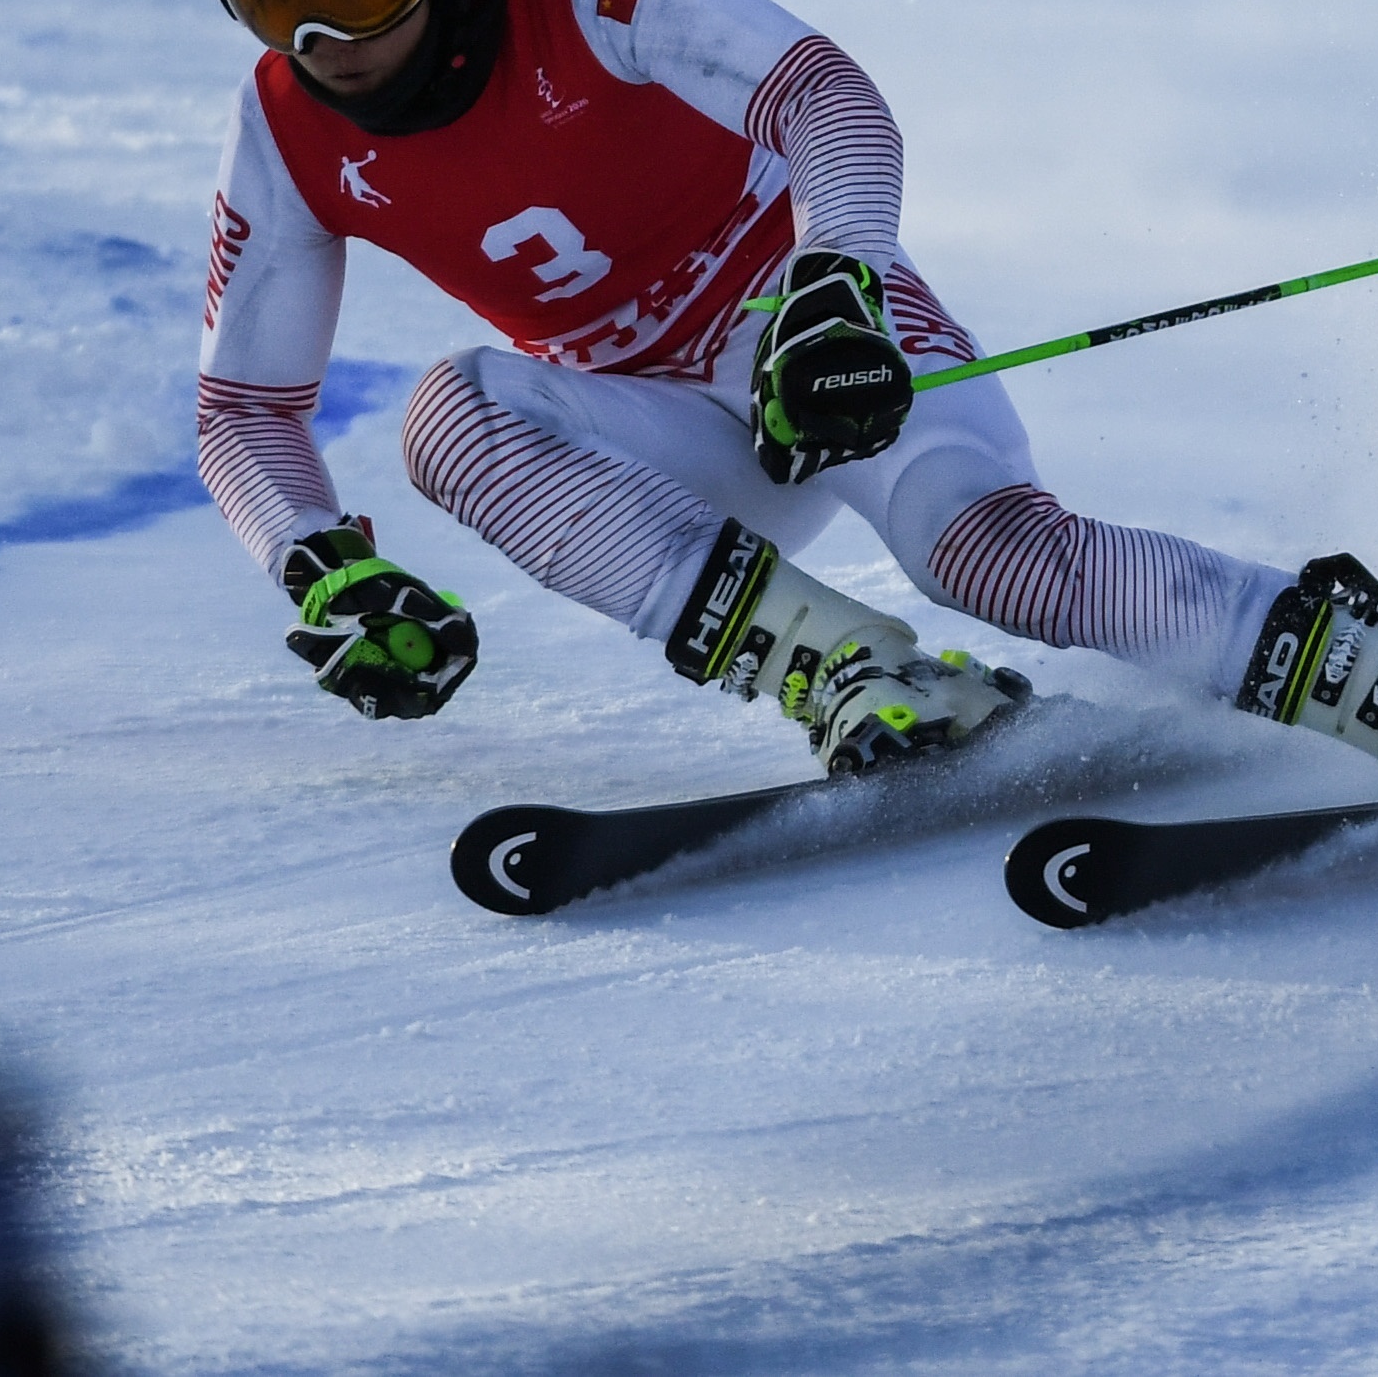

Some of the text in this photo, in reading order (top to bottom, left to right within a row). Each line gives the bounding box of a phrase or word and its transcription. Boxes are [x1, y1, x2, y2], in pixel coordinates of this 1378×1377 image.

[482, 205, 613, 304] 3
[811, 364, 893, 393] reusch
[686, 527, 763, 655] HEAD
